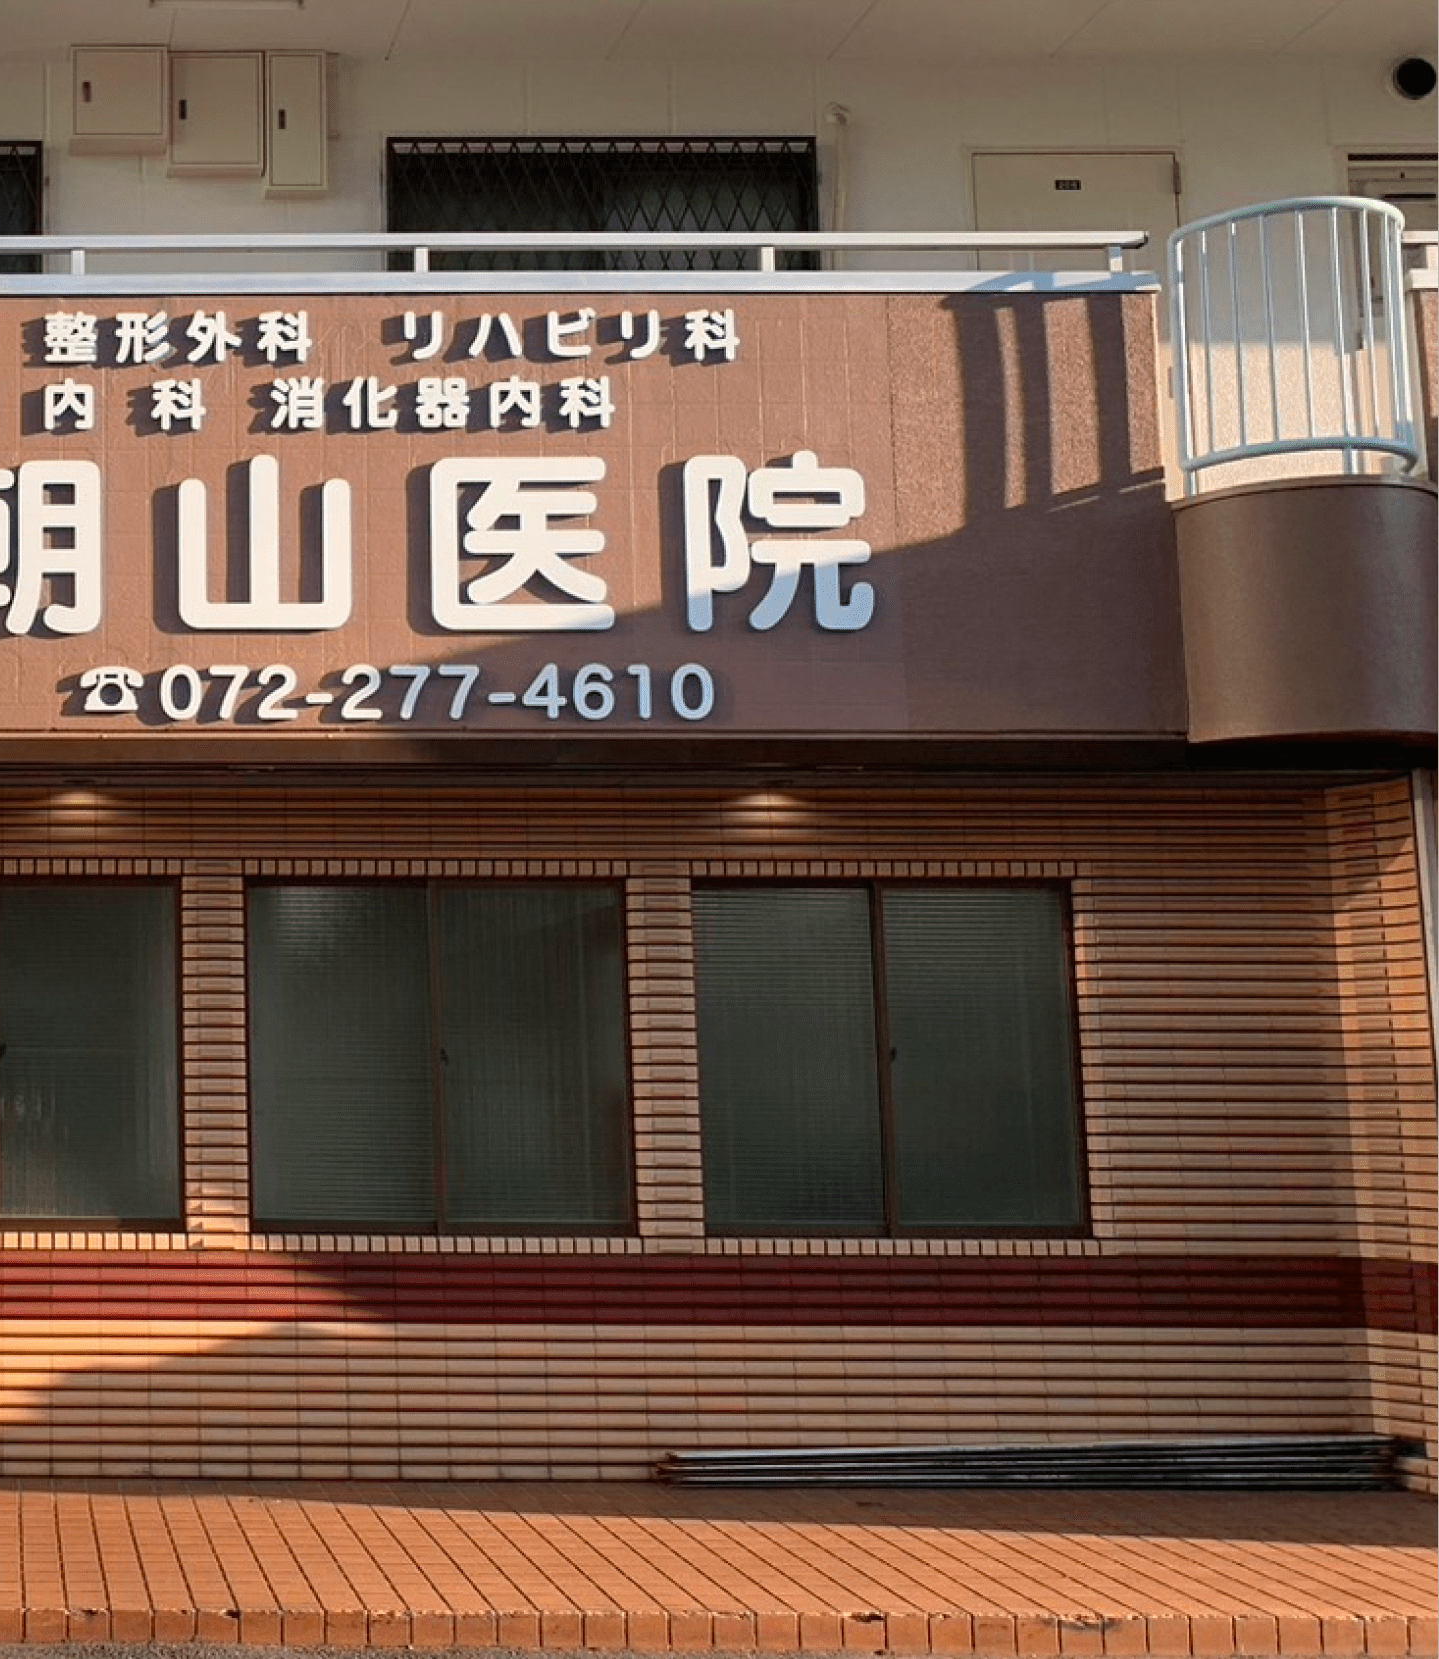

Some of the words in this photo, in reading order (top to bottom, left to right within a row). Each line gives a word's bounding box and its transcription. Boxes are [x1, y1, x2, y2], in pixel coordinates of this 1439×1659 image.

[44, 310, 314, 365] 整形外科
[401, 308, 742, 362] リハビリ科
[269, 376, 618, 431] 消化器内科
[160, 664, 716, 721] 072-277-4610
